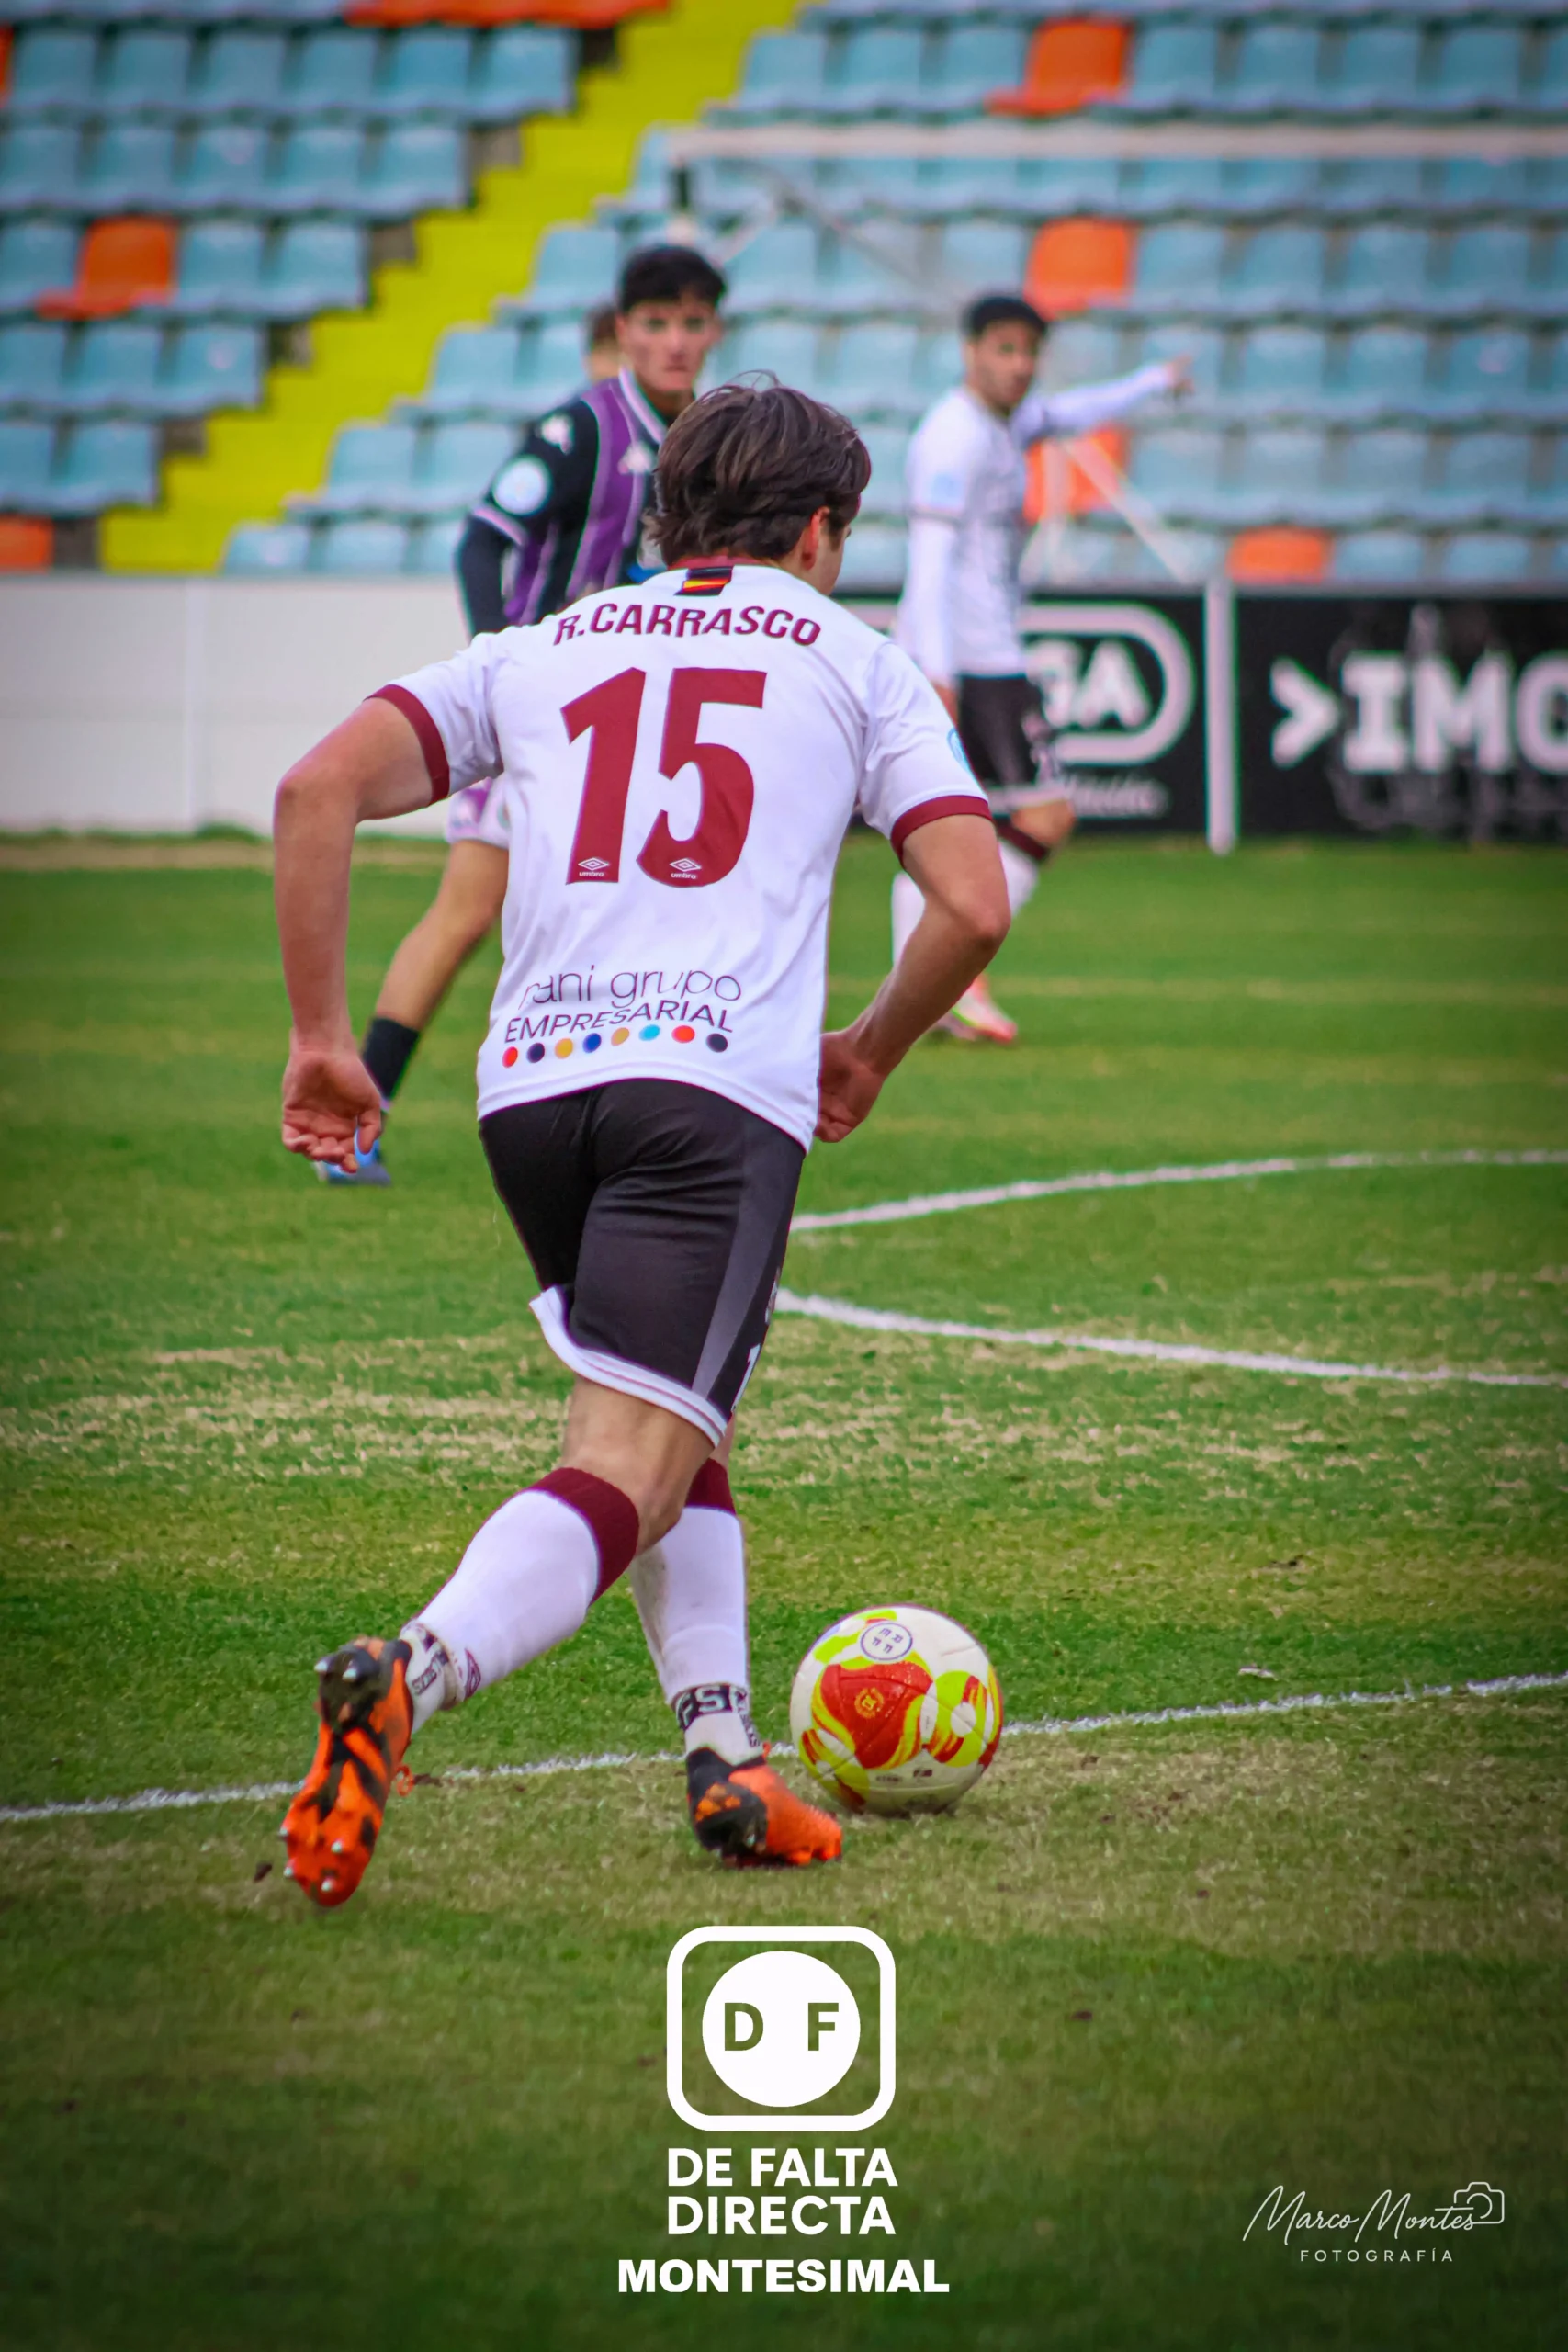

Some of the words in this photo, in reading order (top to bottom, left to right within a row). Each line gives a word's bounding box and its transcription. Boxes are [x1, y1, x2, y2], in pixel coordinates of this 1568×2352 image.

[553, 603, 821, 646] R.CARRASCO
[560, 667, 768, 888] 15
[671, 872, 697, 880] umbro
[610, 970, 741, 1008] grupo
[504, 1000, 733, 1043] EMPRESARIAL
